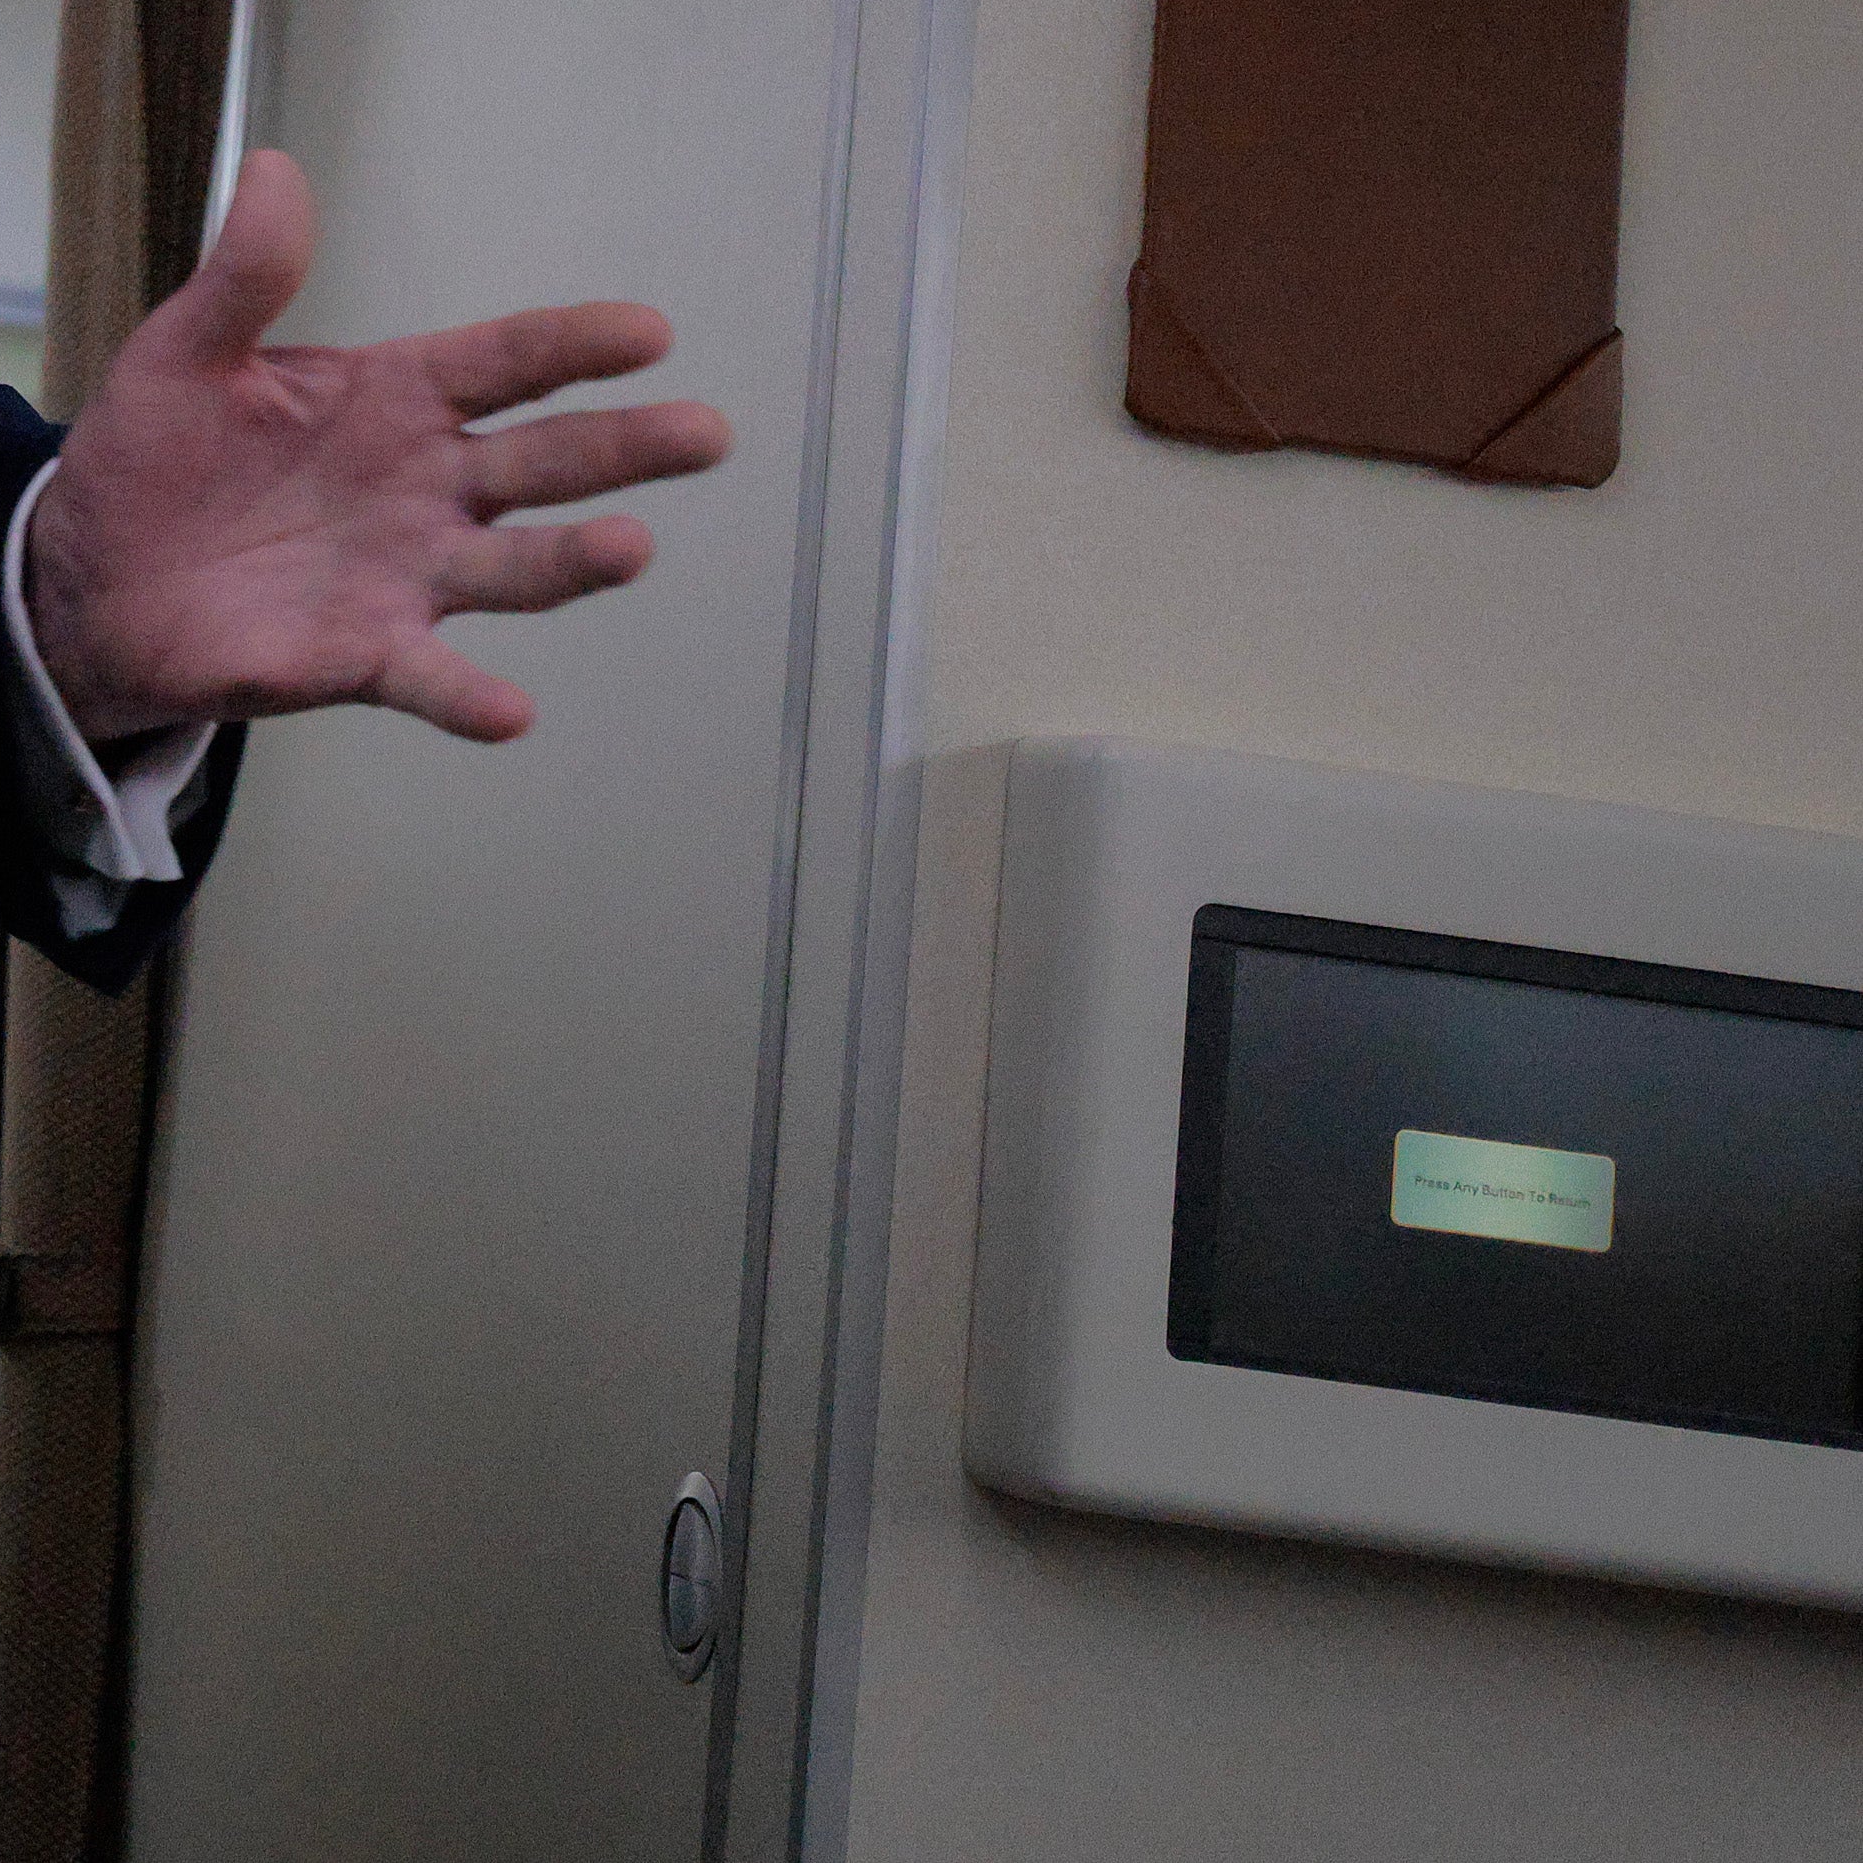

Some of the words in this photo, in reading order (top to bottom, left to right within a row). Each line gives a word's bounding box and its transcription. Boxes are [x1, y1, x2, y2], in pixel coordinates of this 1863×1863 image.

[1415, 1175, 1449, 1190] Press
[1453, 1181, 1479, 1196] Any
[1483, 1184, 1524, 1200] Button
[1529, 1190, 1546, 1203] To
[1549, 1193, 1591, 1208] Return
